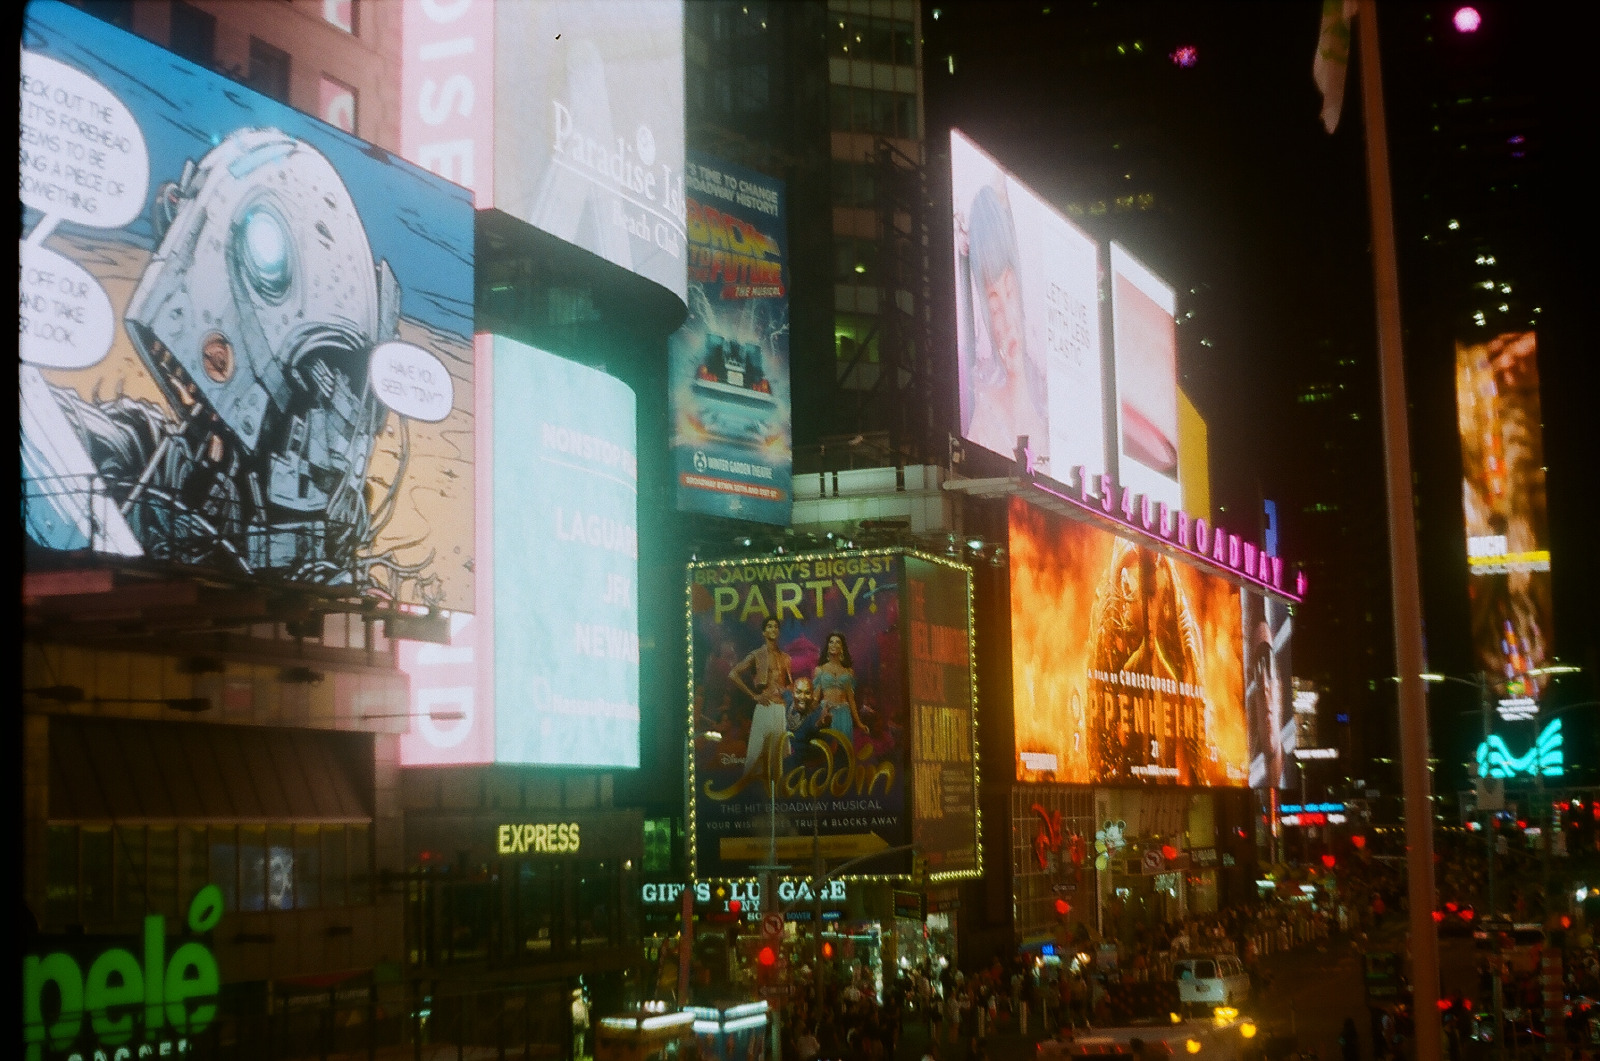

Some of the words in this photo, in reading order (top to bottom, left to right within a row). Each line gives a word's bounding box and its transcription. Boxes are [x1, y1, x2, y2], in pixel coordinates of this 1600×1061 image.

[90, 101, 113, 125] THE
[66, 140, 84, 160] TO
[89, 148, 106, 170] BE
[552, 101, 656, 201] Paradise
[107, 180, 125, 197] OF
[723, 173, 738, 190] TO
[738, 180, 778, 204] CHANGE
[736, 192, 779, 217] HISTORY
[686, 198, 781, 258] BACK
[710, 249, 782, 285] FUTURE
[27, 267, 55, 285] OFF
[60, 277, 89, 299] OUR
[735, 285, 752, 297] THE
[34, 323, 78, 348] LOOK
[542, 422, 621, 467] NONSTOP
[1078, 465, 1152, 531] 1540
[1159, 502, 1285, 590] BROADWAY
[694, 562, 812, 586] BROADWAY'S
[815, 556, 893, 578] BIGGEST
[714, 577, 878, 625] PARTY!
[1119, 669, 1178, 695] CHRISTOPHER
[1179, 681, 1205, 699] NOLAN
[703, 729, 896, 802] Aladdin
[720, 803, 742, 814] THE
[744, 802, 761, 814] HIT
[765, 800, 829, 813] BROADWAY
[832, 799, 882, 811] MUSICAL
[706, 820, 731, 829] YOUR
[821, 819, 828, 827] 4
[832, 816, 868, 827] BLOCKS
[871, 815, 898, 825] AWAY
[499, 822, 581, 853] EXPRESS
[741, 900, 760, 912] NY
